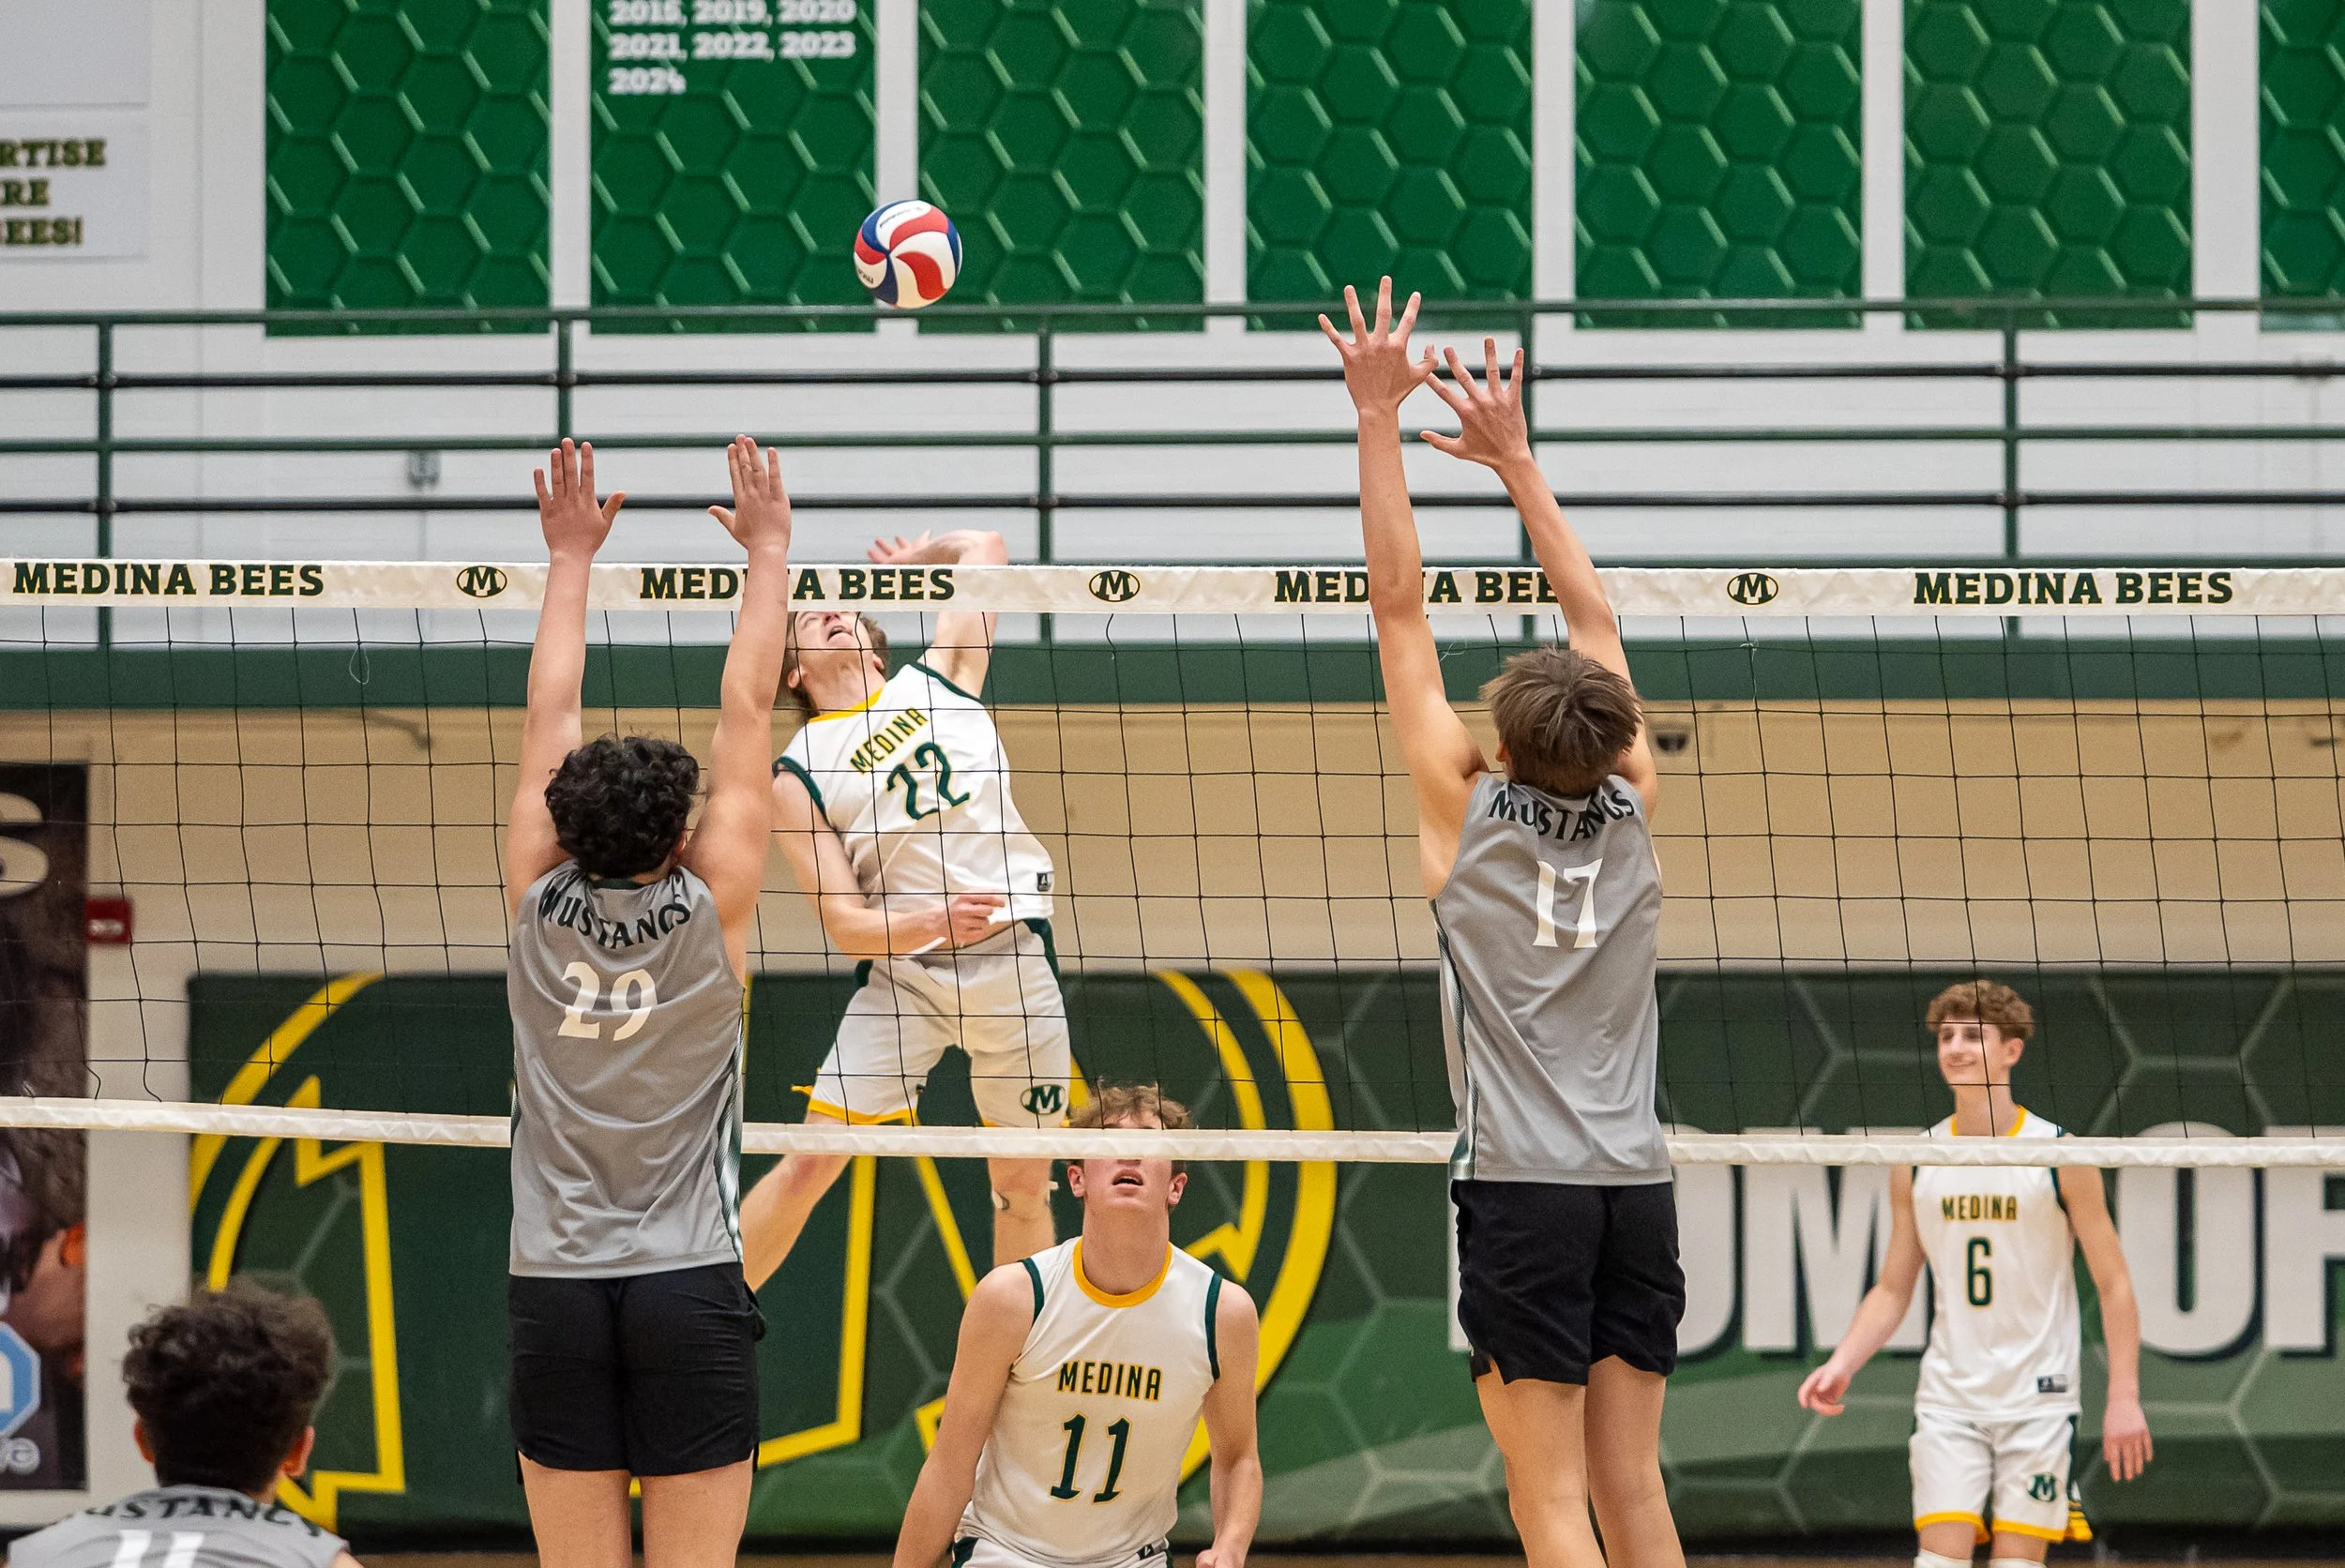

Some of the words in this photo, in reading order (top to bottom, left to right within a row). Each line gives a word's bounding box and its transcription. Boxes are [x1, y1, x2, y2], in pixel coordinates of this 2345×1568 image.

[691, 0, 773, 27] 2019,
[778, 0, 856, 24] 2020
[608, 33, 688, 62] 2021,
[691, 31, 775, 63] 2022,
[778, 30, 855, 59] 2023
[608, 67, 687, 95] 2024
[0, 218, 83, 246] EES!
[12, 563, 197, 596] MEDINA
[209, 564, 325, 596] BEES
[461, 565, 504, 597] M
[640, 567, 825, 600] MEDA
[839, 568, 955, 601] BEES
[1094, 570, 1136, 602] M
[1274, 570, 1462, 603] MEDA
[1475, 571, 1560, 604] BEE
[1732, 573, 1774, 605] M
[1914, 572, 2102, 605] MEDINA
[2115, 571, 2233, 604] BEES
[850, 707, 929, 775] MEDINA
[886, 741, 971, 822] 22
[1488, 789, 1635, 842] MUSTANGS
[1532, 857, 1598, 949] 17
[557, 961, 658, 1042] 29
[1024, 1085, 1064, 1114] M
[1941, 1194, 2019, 1221] MEDINA
[1967, 1235, 1994, 1309] 6
[1057, 1360, 1164, 1403] MEDINA
[1050, 1410, 1132, 1505] 11
